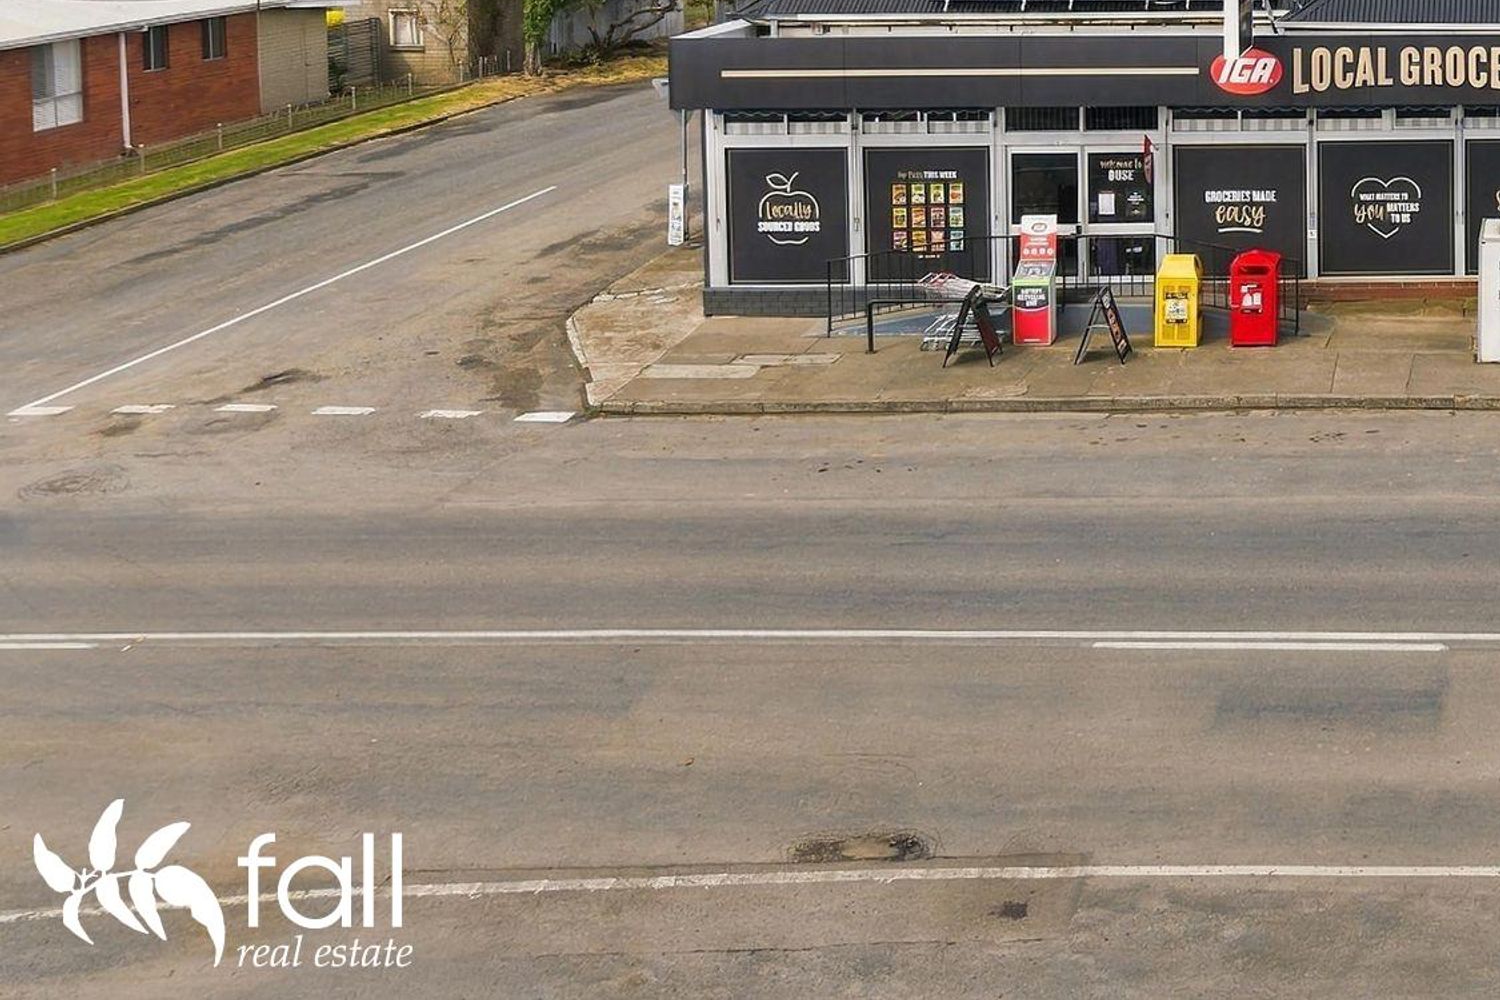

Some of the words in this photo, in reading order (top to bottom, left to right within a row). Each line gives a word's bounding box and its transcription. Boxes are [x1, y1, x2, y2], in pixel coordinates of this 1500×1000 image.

[1218, 57, 1276, 84] IGA
[1293, 46, 1393, 94] LOCAL
[1205, 190, 1251, 203] GROCERIES
[1252, 190, 1277, 202] MADE
[1215, 204, 1267, 227] easy
[1354, 203, 1384, 224] you
[1386, 202, 1420, 213] MATTERS
[1390, 213, 1400, 223] TO
[1401, 213, 1411, 223] US
